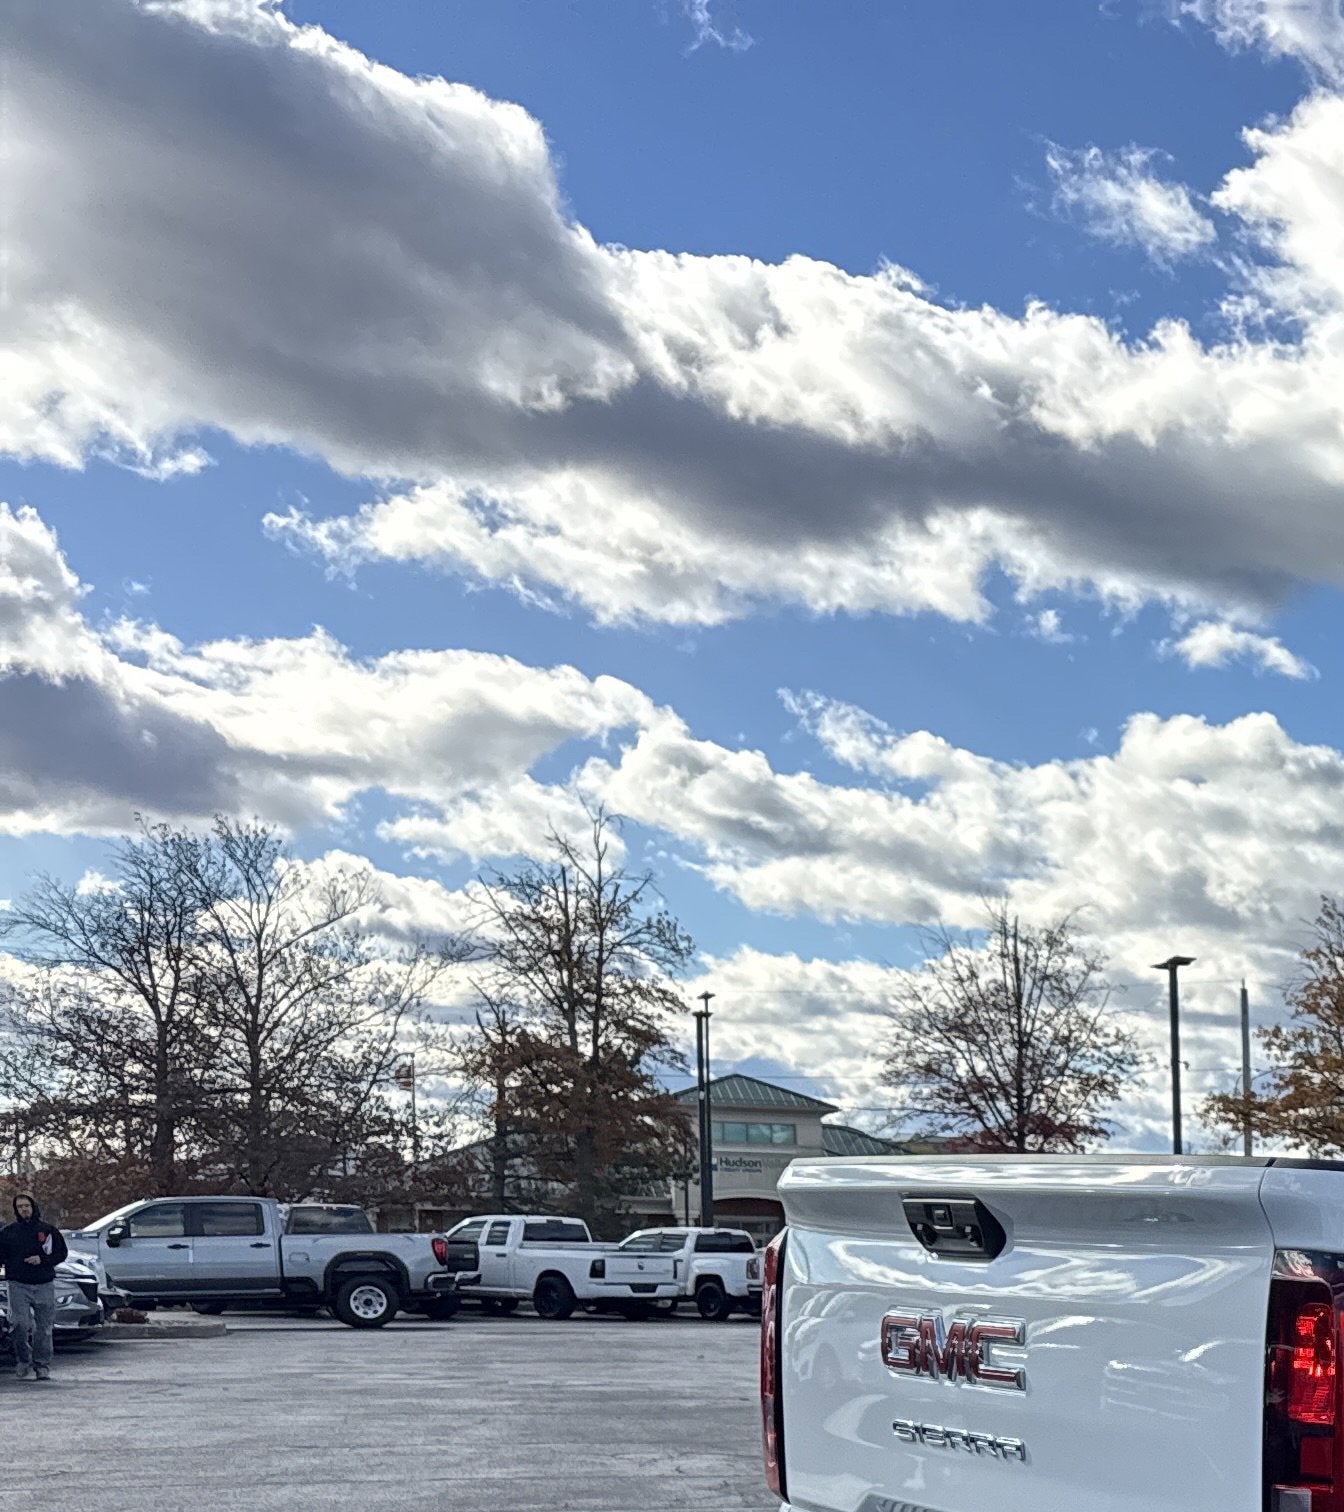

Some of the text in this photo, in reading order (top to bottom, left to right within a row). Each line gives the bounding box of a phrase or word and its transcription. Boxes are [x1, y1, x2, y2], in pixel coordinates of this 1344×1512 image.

[719, 1157, 762, 1168] Hudson
[881, 1304, 1027, 1398] GMC
[892, 1418, 1027, 1461] SIERRA
